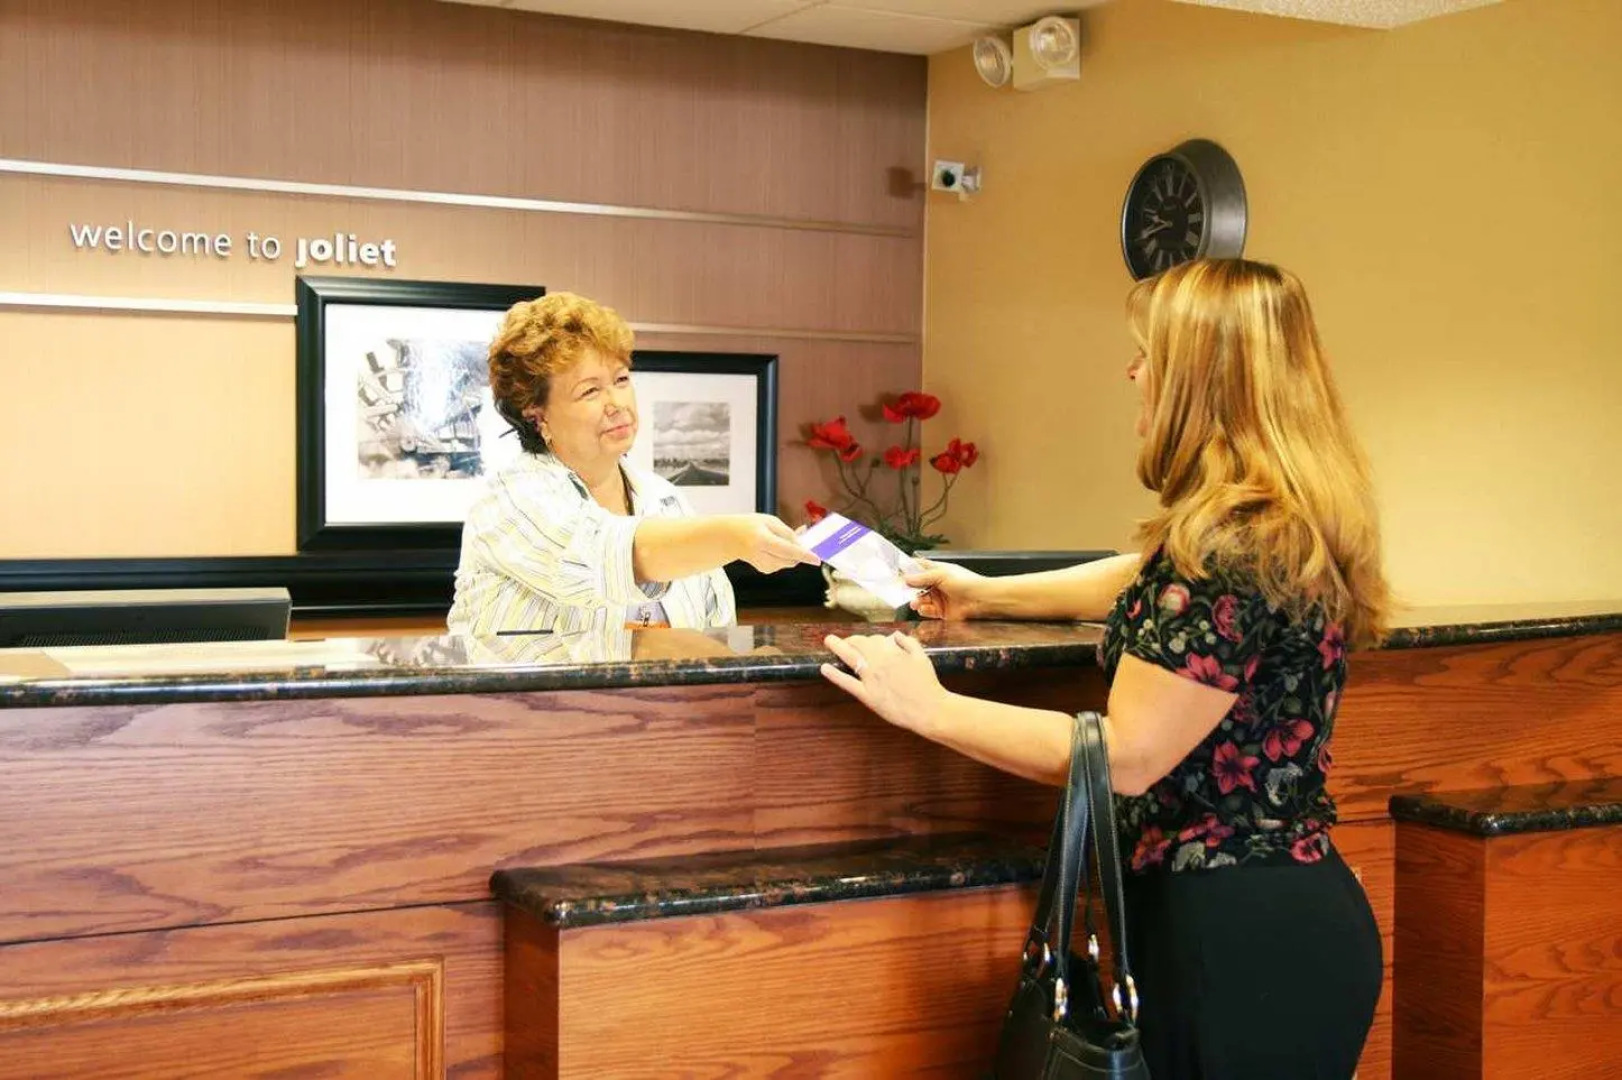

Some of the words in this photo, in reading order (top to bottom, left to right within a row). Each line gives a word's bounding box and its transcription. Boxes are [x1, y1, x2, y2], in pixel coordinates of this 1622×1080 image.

[70, 220, 232, 258] welcome
[247, 231, 281, 259] to
[295, 233, 397, 267] joliet
